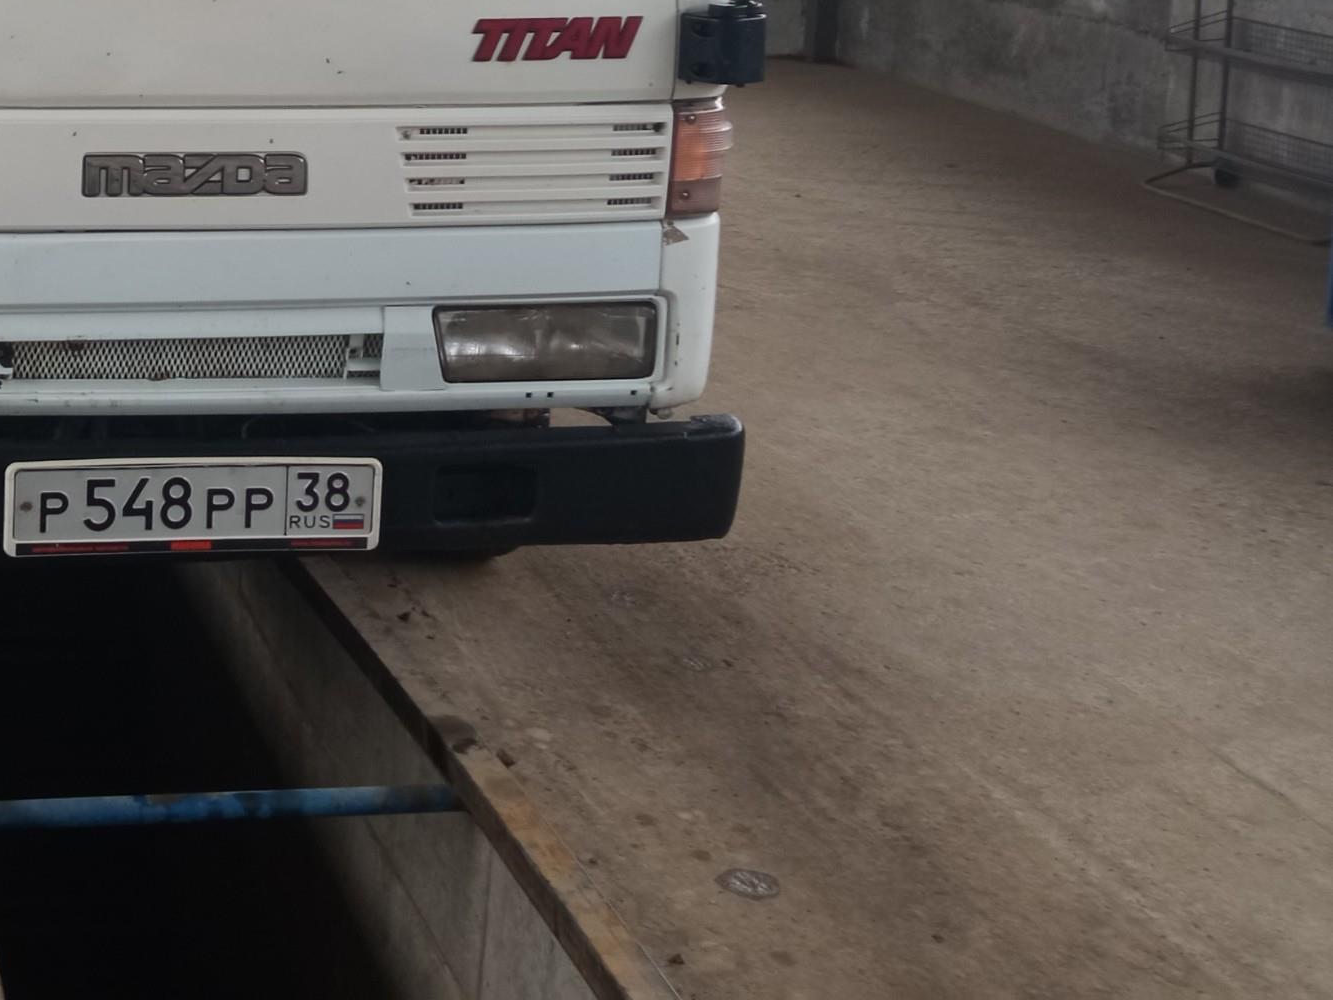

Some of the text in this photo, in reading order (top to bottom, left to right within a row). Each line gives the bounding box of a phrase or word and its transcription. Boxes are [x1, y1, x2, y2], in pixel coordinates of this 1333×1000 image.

[472, 16, 643, 62] TITAN
[82, 152, 308, 197] mazda
[295, 472, 350, 512] 38
[289, 514, 331, 529] RUS
